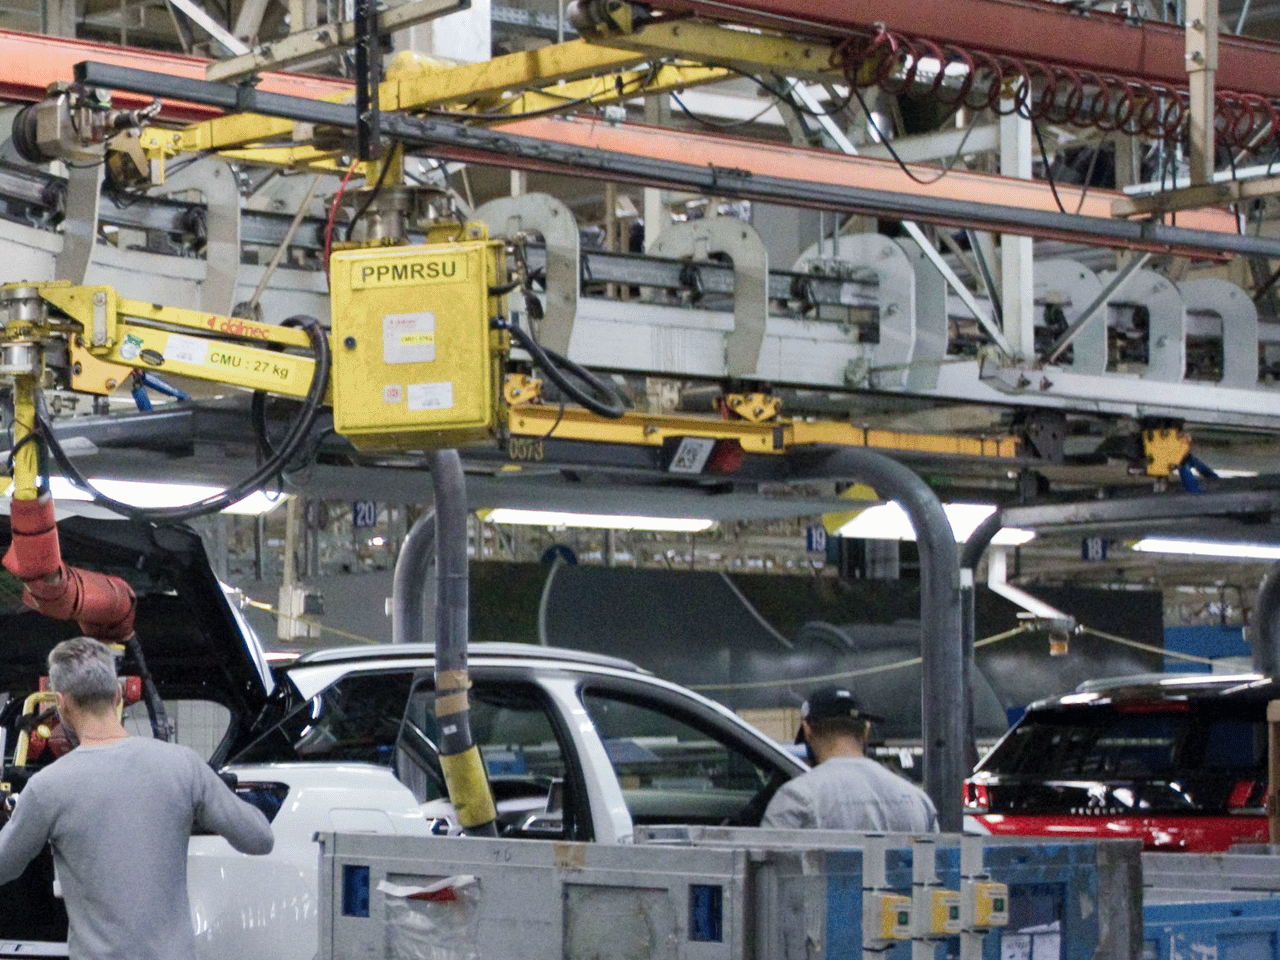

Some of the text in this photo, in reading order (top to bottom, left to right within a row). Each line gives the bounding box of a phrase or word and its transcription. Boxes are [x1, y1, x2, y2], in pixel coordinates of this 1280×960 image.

[361, 260, 456, 283] PPMRSU
[219, 319, 270, 341] dalmec
[210, 351, 242, 368] CMU
[253, 360, 270, 373] 27
[273, 364, 289, 380] kg
[357, 501, 375, 526] 20
[1088, 537, 1102, 561] 18
